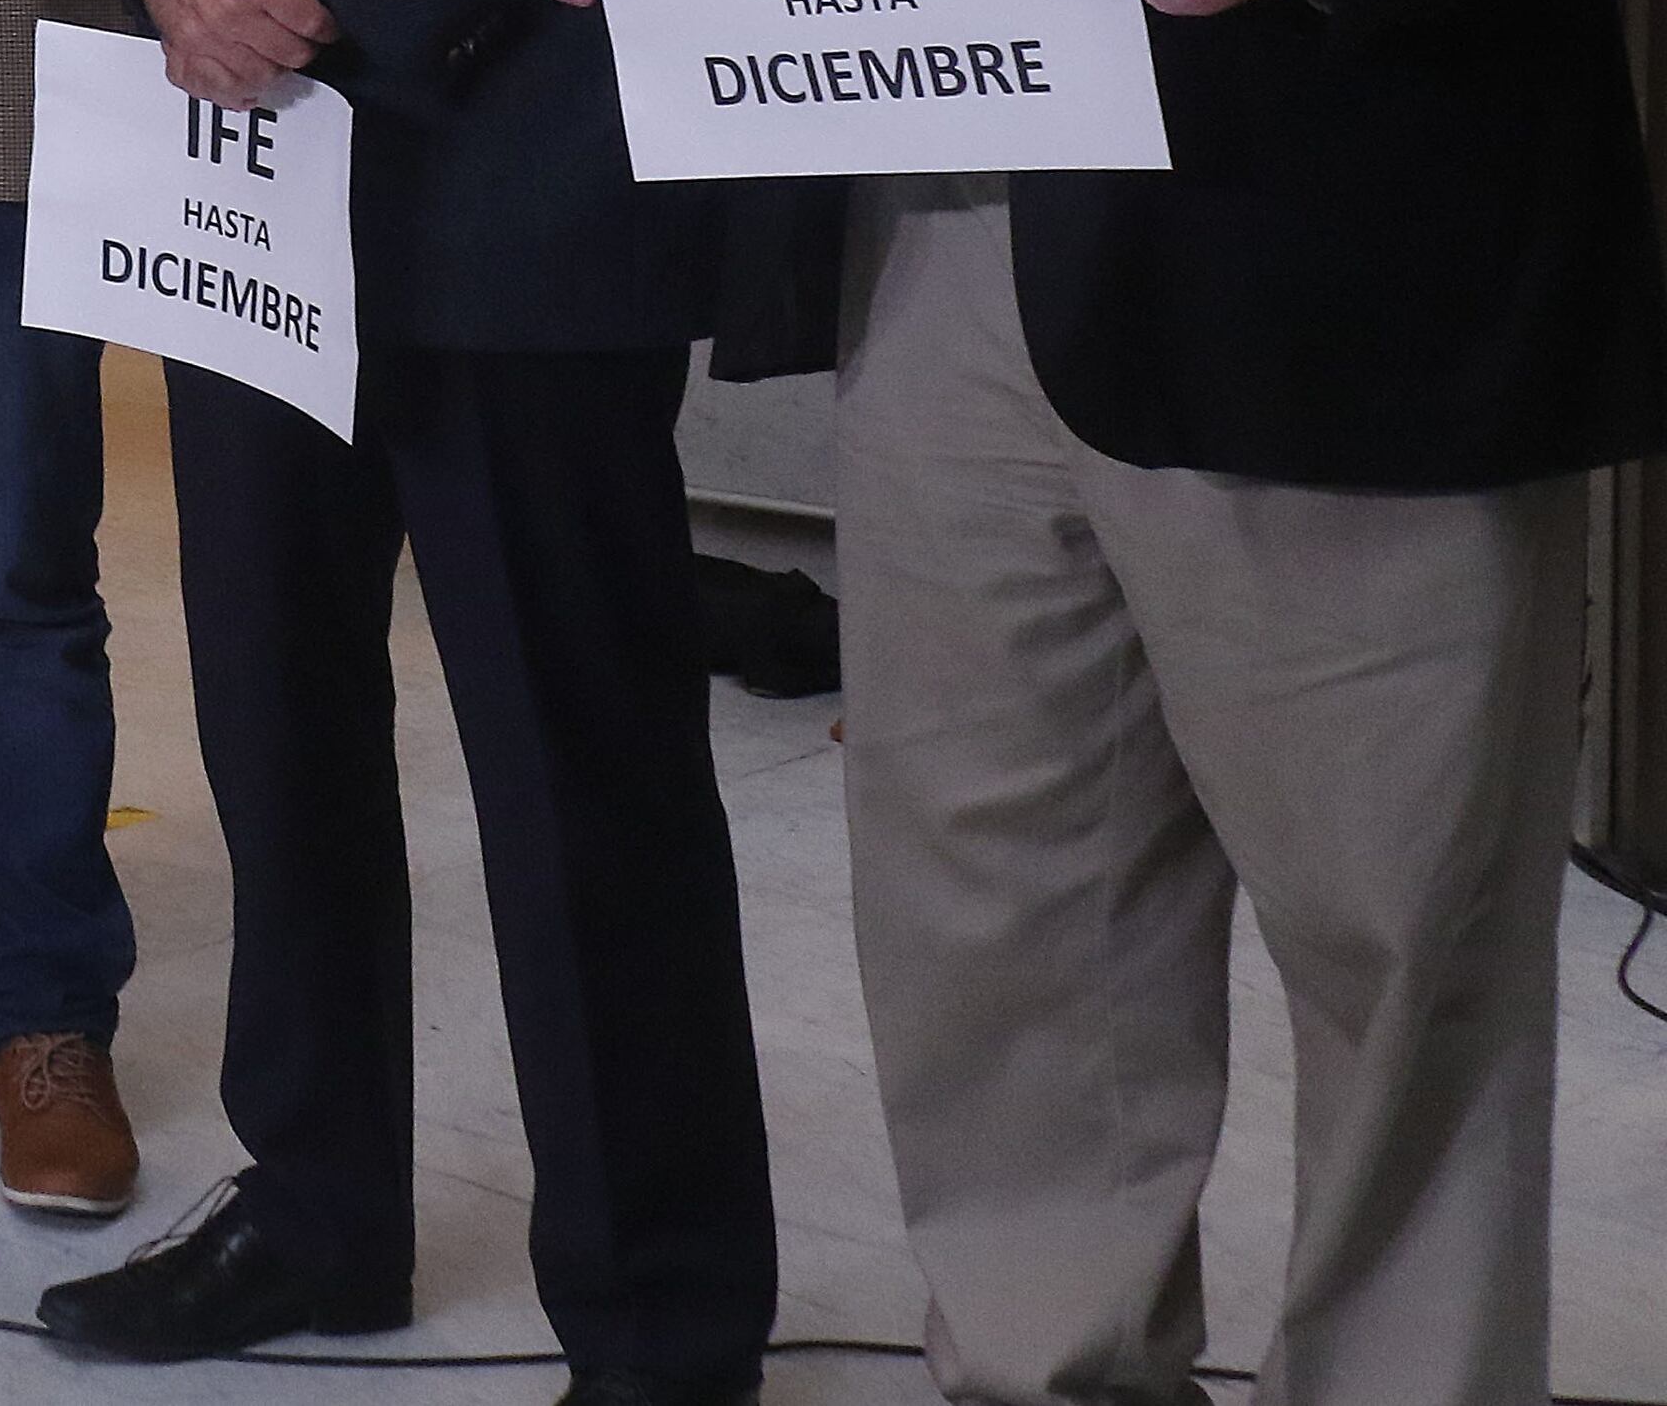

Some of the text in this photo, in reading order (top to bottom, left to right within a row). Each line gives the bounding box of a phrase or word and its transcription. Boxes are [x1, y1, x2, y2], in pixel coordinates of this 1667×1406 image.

[702, 38, 1053, 107] DICIEMBRE
[186, 94, 279, 181] IFE
[182, 196, 272, 253] HASTA
[100, 237, 323, 354] DICIEMBRE
